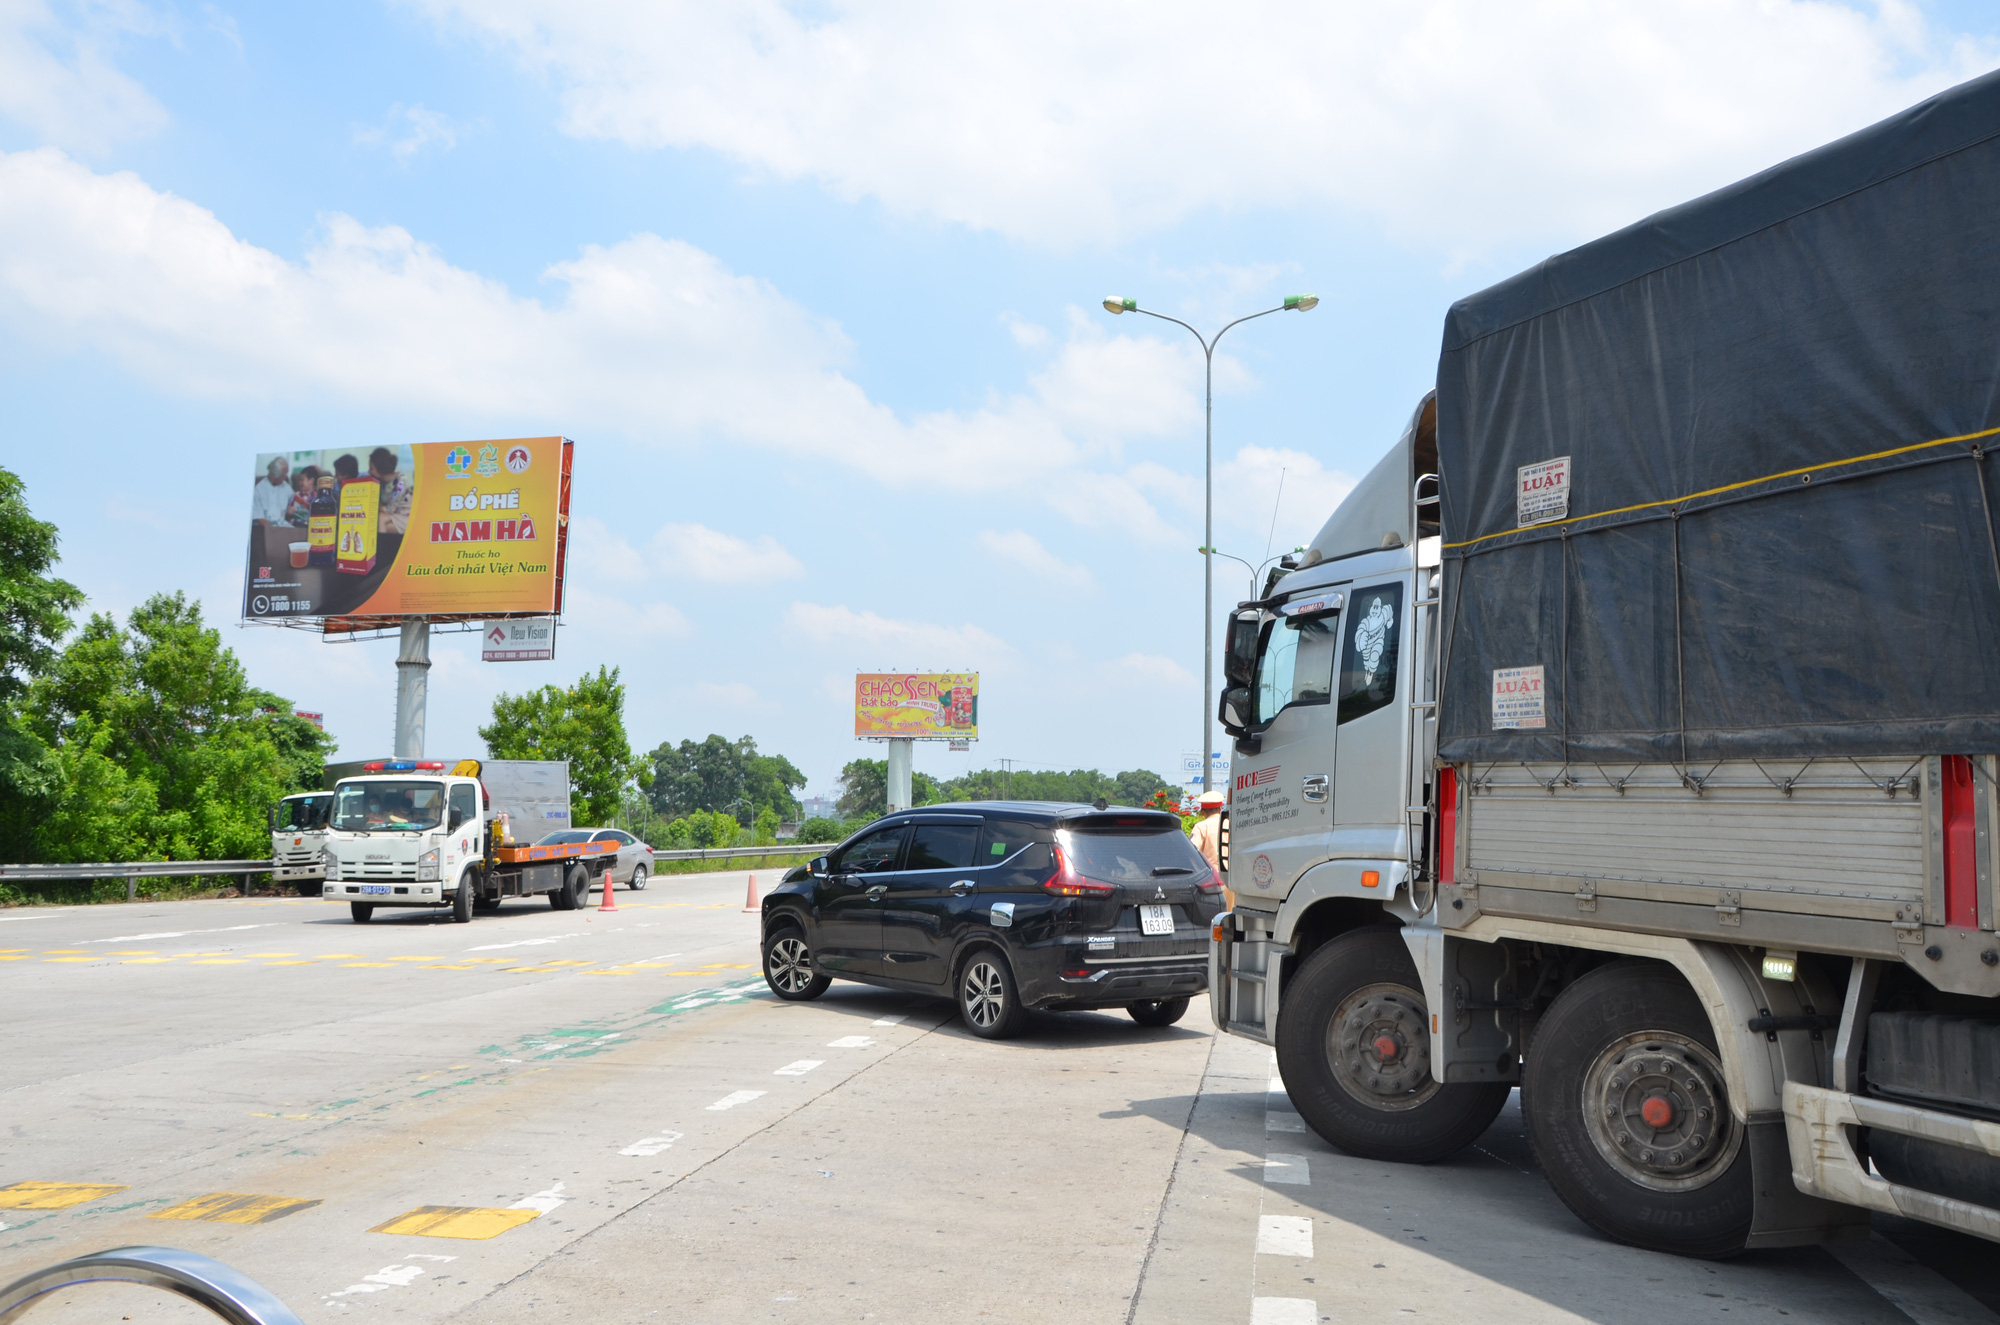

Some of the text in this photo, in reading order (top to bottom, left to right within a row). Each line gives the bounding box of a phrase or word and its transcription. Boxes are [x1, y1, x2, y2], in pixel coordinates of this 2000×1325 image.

[1522, 472, 1564, 492] LUẬT
[449, 487, 520, 511] BỔ PHẾ
[430, 513, 537, 543] NAM HÀ
[456, 549, 501, 559] Thuốc ho
[407, 564, 430, 576] Lâu
[457, 560, 486, 574] nhất
[489, 562, 514, 576] Việt
[517, 562, 548, 573] Nam
[271, 601, 310, 612] 1800 1155
[1300, 602, 1322, 613] AUMAN
[510, 625, 548, 640] New Vision
[1496, 677, 1542, 695] LUẬT
[861, 696, 898, 707] Bát bảo
[920, 700, 938, 710] TRUNG
[1236, 771, 1258, 790] HCE
[1265, 788, 1282, 798] Express
[552, 847, 564, 856] SÁT
[568, 846, 582, 854] GIAO
[586, 844, 603, 852] THÔNG
[1148, 906, 1165, 918] 18A
[1144, 919, 1172, 932] 163.09
